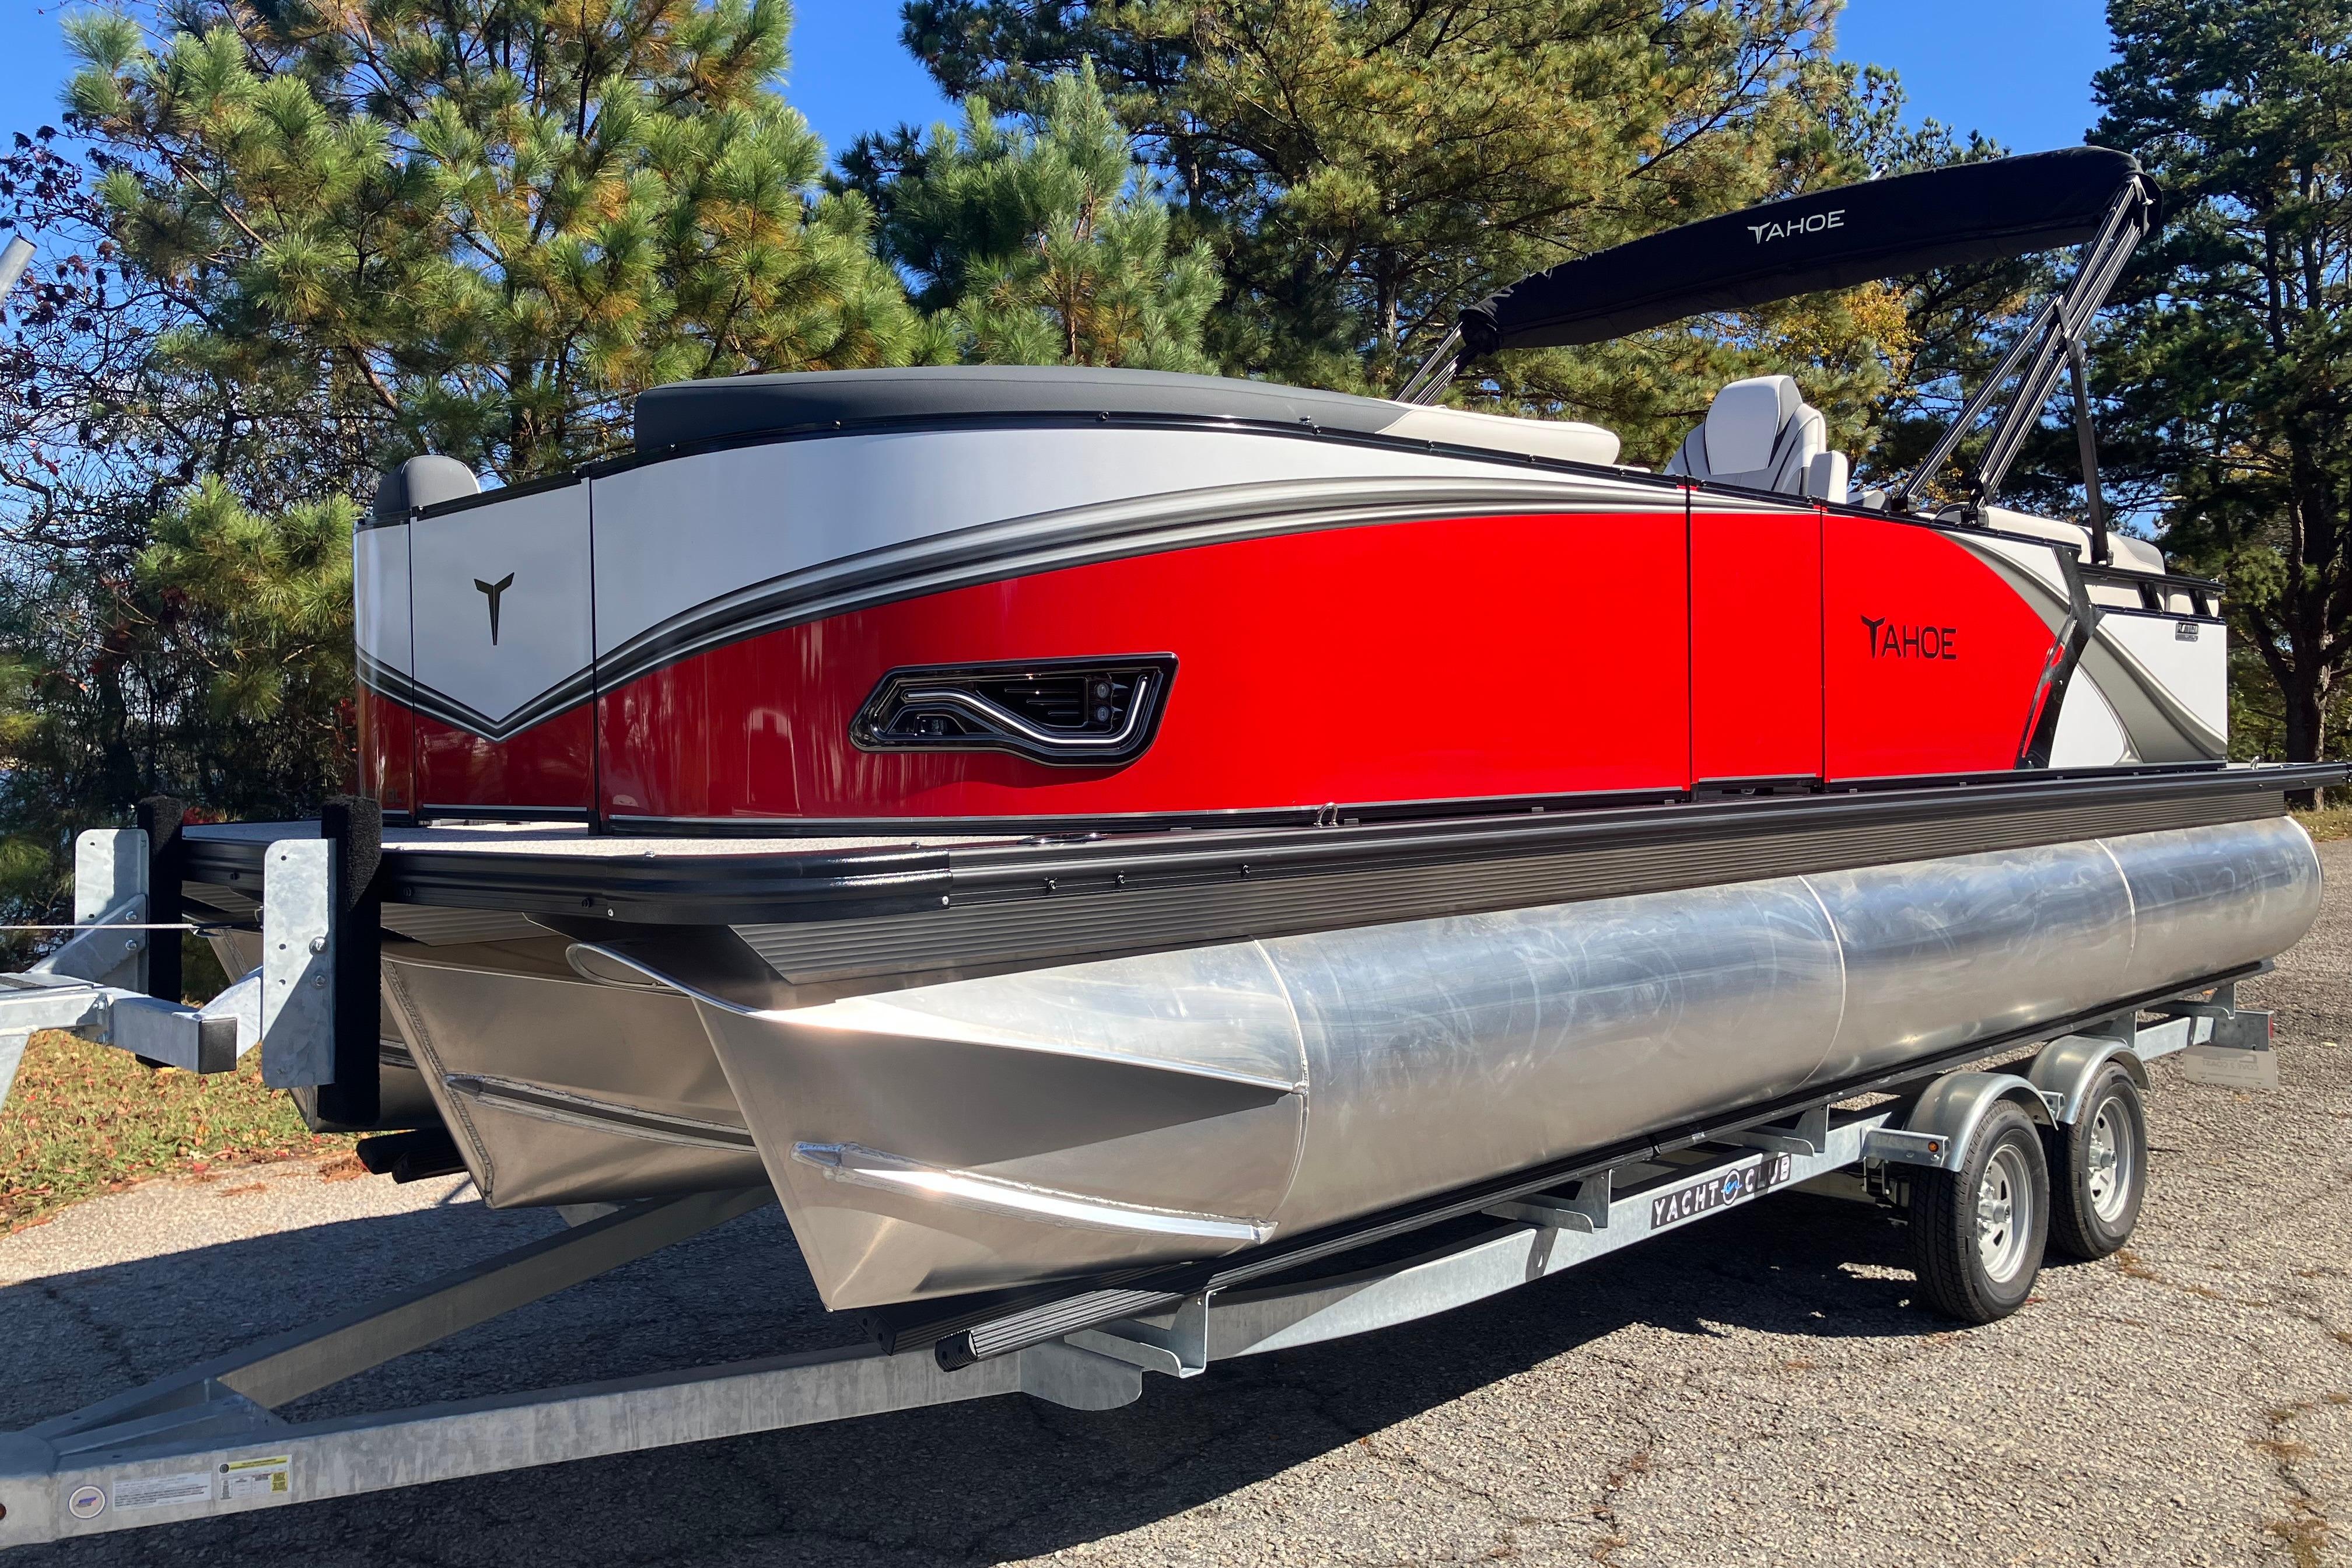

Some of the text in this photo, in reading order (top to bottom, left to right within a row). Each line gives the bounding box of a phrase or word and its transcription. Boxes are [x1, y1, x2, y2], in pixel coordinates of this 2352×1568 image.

[1747, 209, 1845, 244] TAHOE
[1860, 614, 1957, 660] TAHOE
[1654, 1155, 1790, 1225] YACHT CLUB
